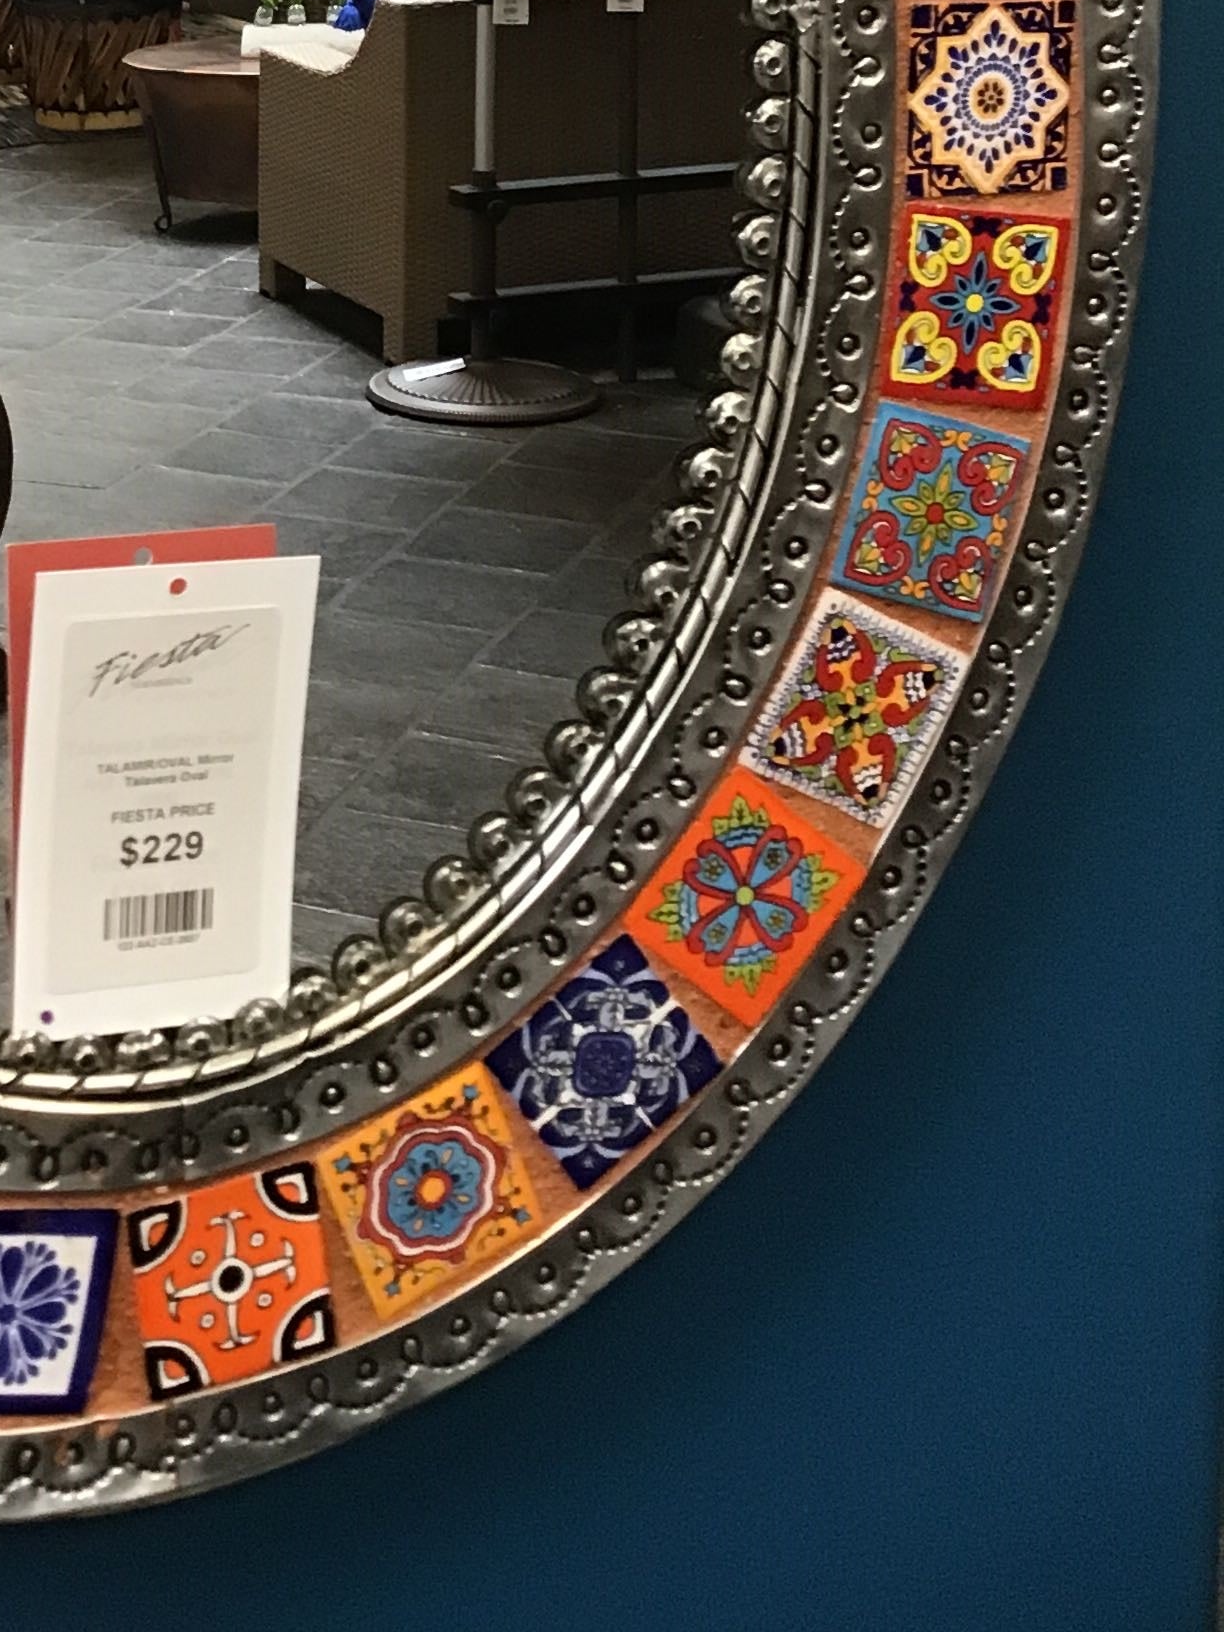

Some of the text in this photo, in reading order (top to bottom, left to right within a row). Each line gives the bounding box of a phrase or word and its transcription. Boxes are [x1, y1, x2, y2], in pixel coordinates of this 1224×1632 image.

[87, 624, 251, 698] Fiesta
[179, 770, 209, 782] Oval
[110, 801, 215, 824] FIESTA PRICE
[119, 830, 204, 869] $229
